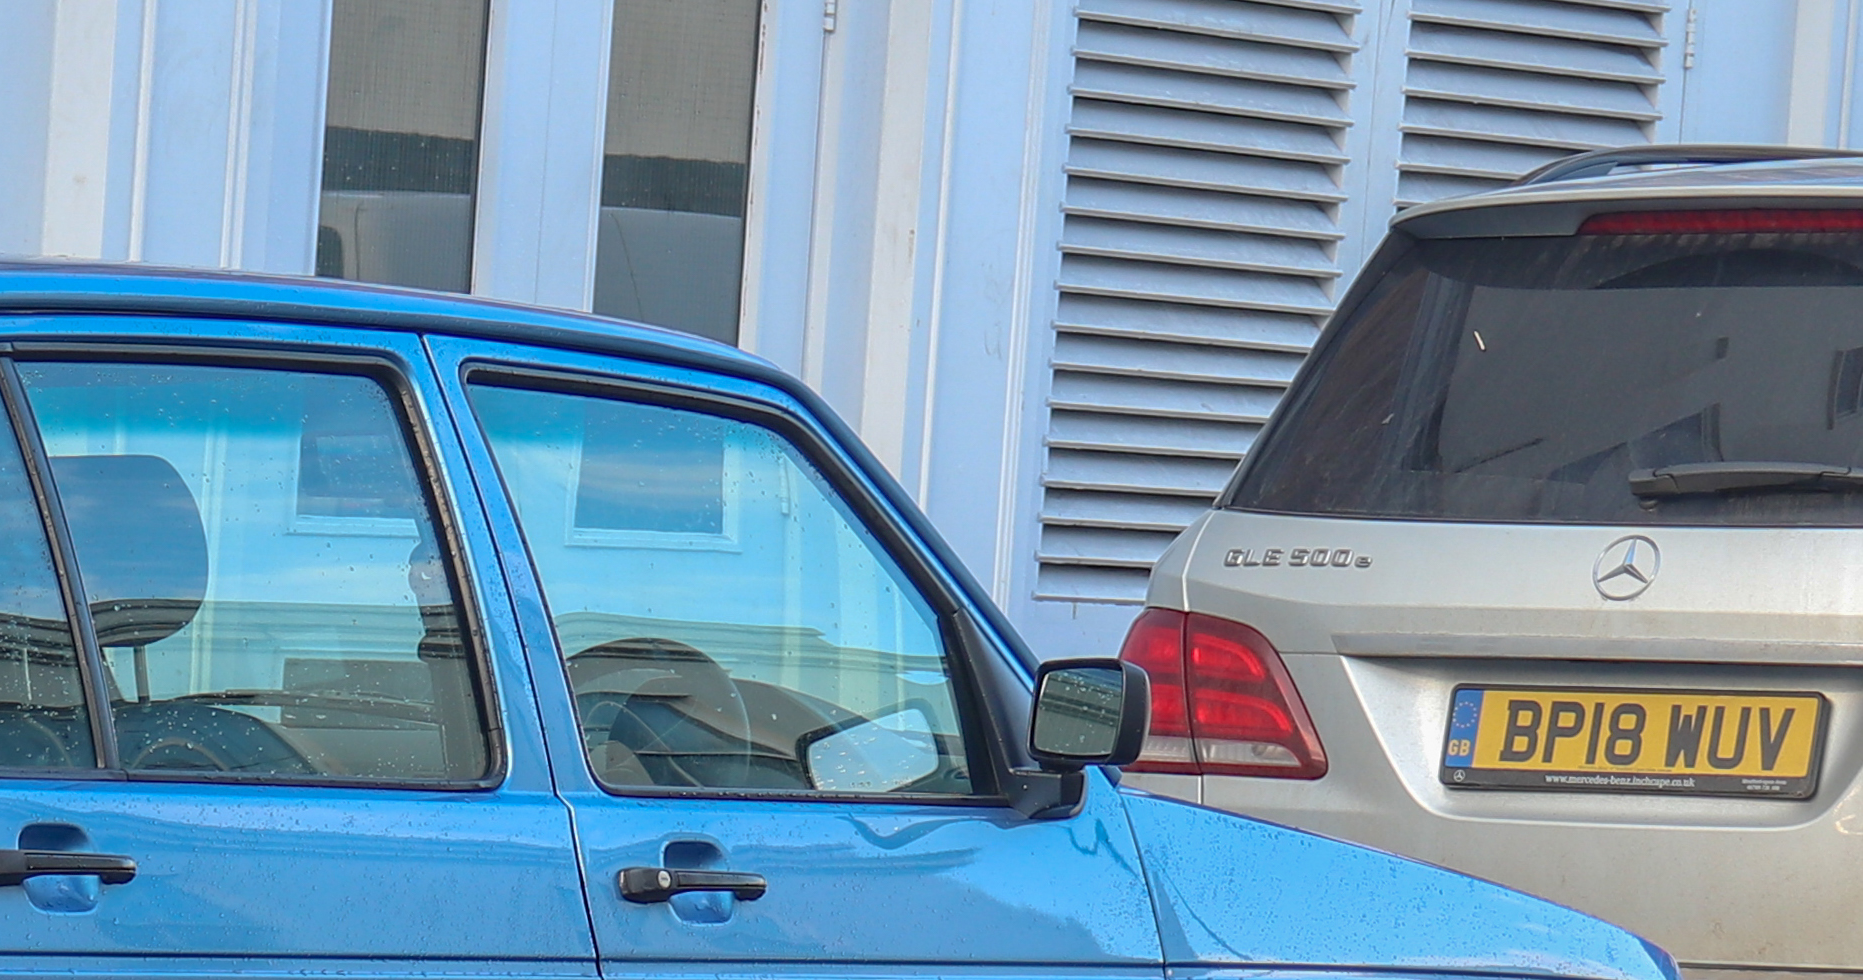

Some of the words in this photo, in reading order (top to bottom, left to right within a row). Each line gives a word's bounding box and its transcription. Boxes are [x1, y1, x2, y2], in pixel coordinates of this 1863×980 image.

[1224, 548, 1284, 568] GLE
[1288, 548, 1373, 568] 500e
[1499, 699, 1647, 766] BP18
[1664, 704, 1797, 771] WUV
[1447, 738, 1471, 757] GB
[1544, 773, 1696, 789] www.mercedes-benz.inchcape.co.uk
